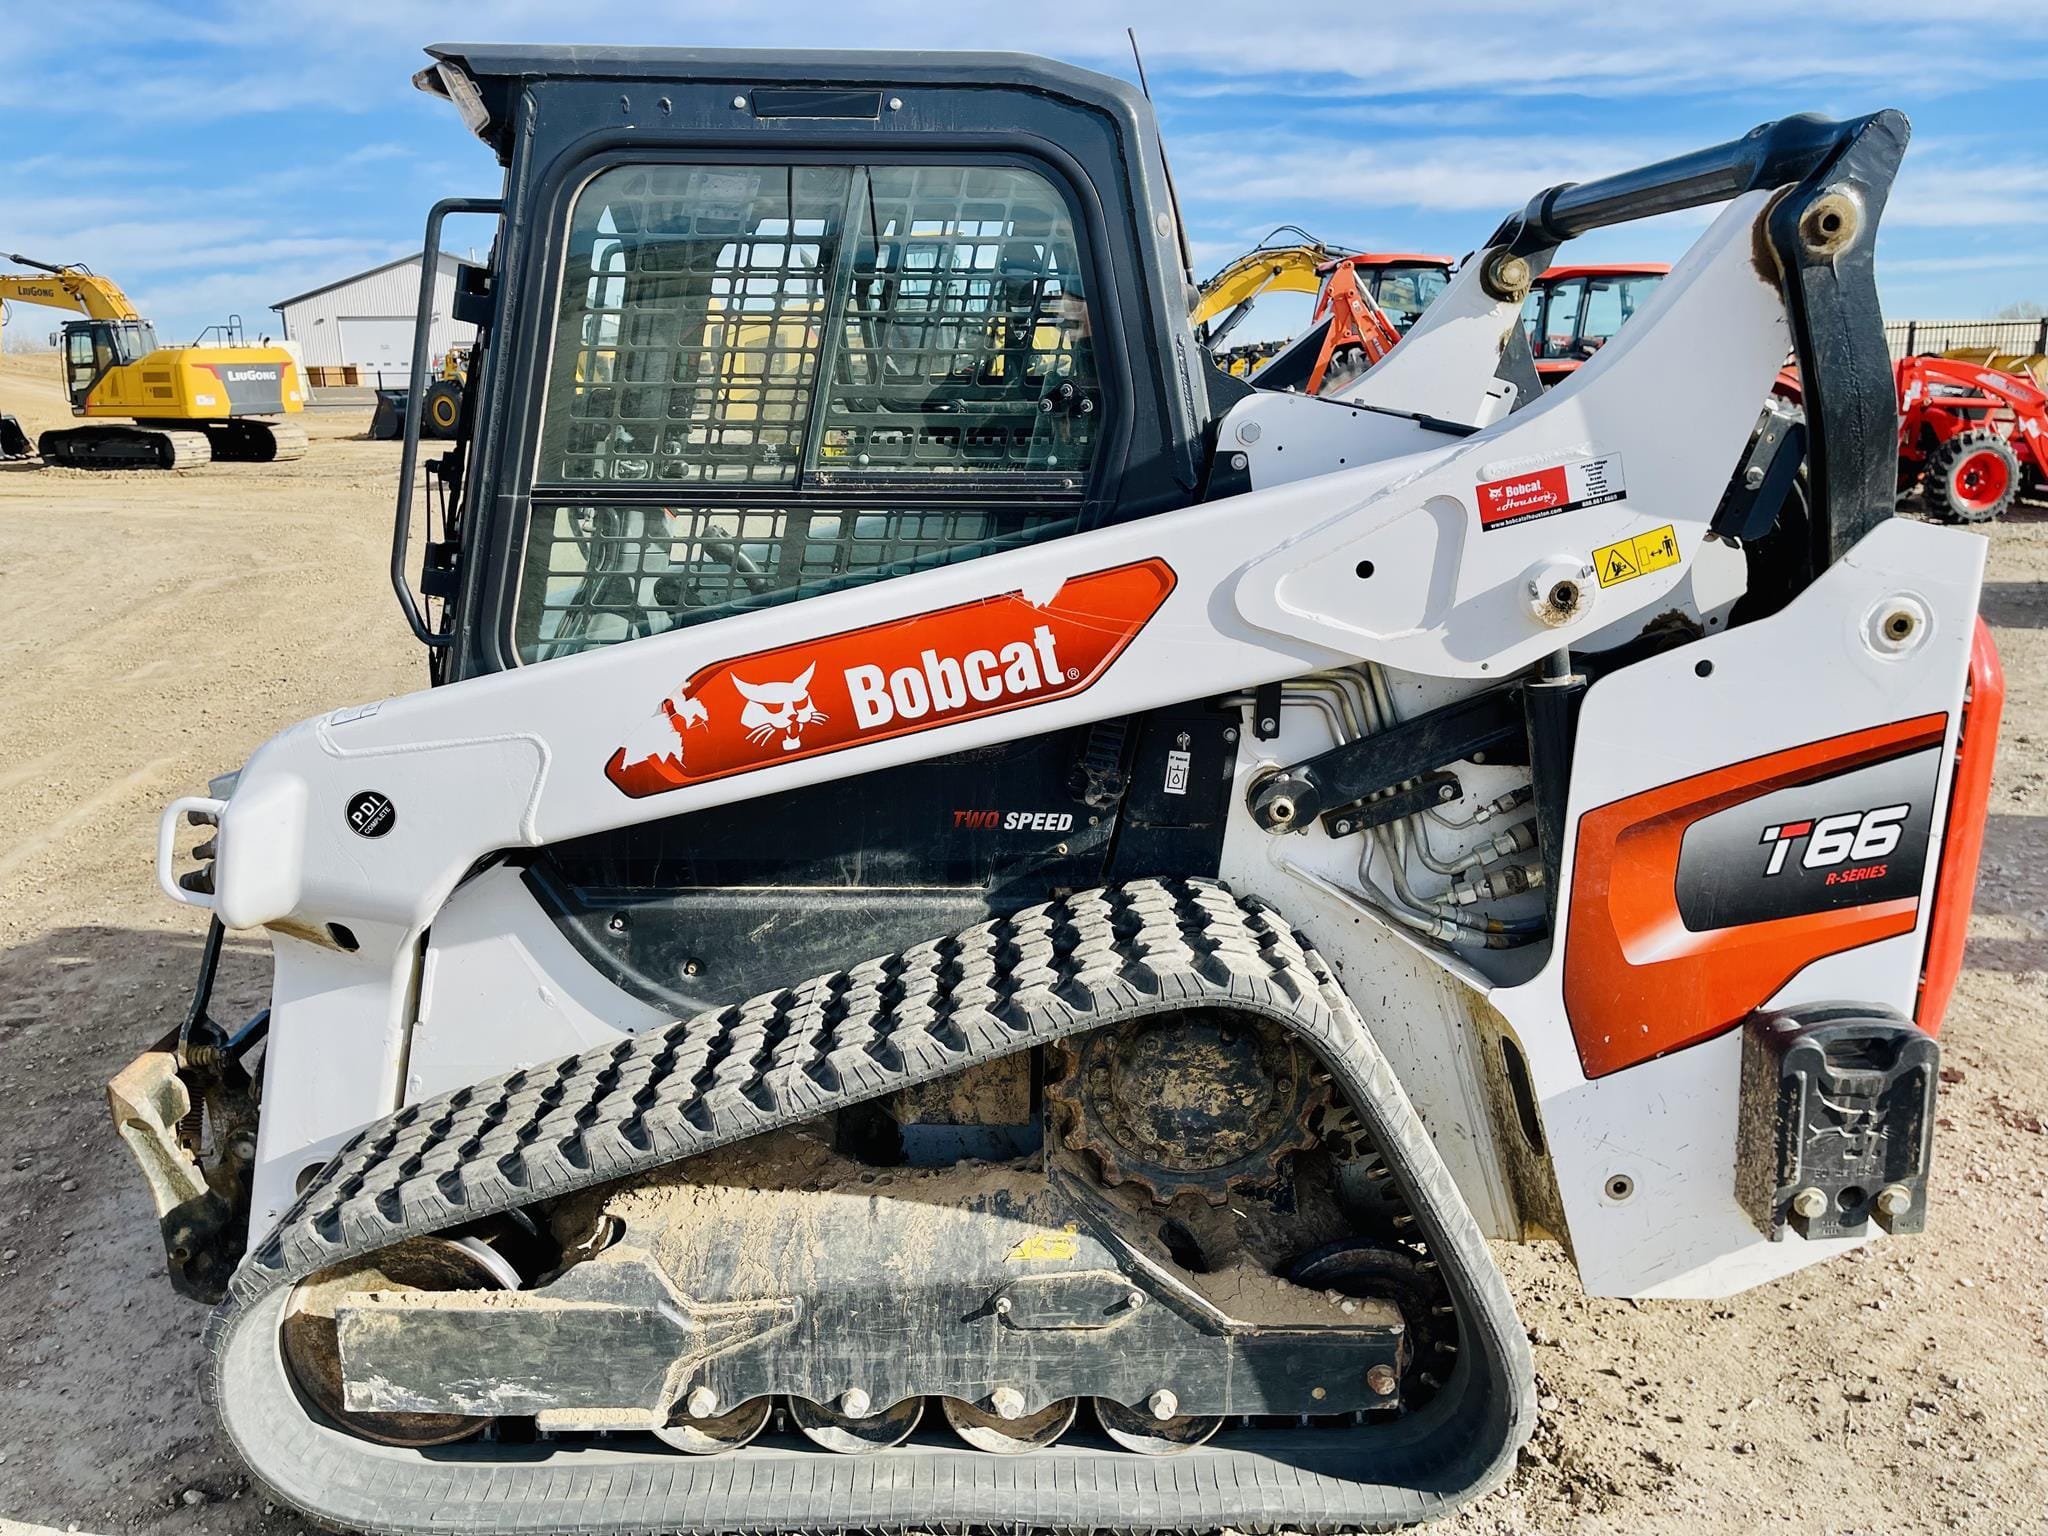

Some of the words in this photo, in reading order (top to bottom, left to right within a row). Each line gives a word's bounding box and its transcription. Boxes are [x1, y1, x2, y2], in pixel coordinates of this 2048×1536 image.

[1505, 479, 1542, 498] Bobcat
[1501, 493, 1552, 511] Houston
[843, 624, 1065, 730] Bobcat
[351, 795, 381, 825] PDI
[364, 806, 391, 834] COMPLETE
[952, 809, 999, 830] TWO
[1003, 811, 1074, 832] SPEED
[1760, 803, 1911, 877] T66
[1825, 864, 1888, 885] R-SERIES
